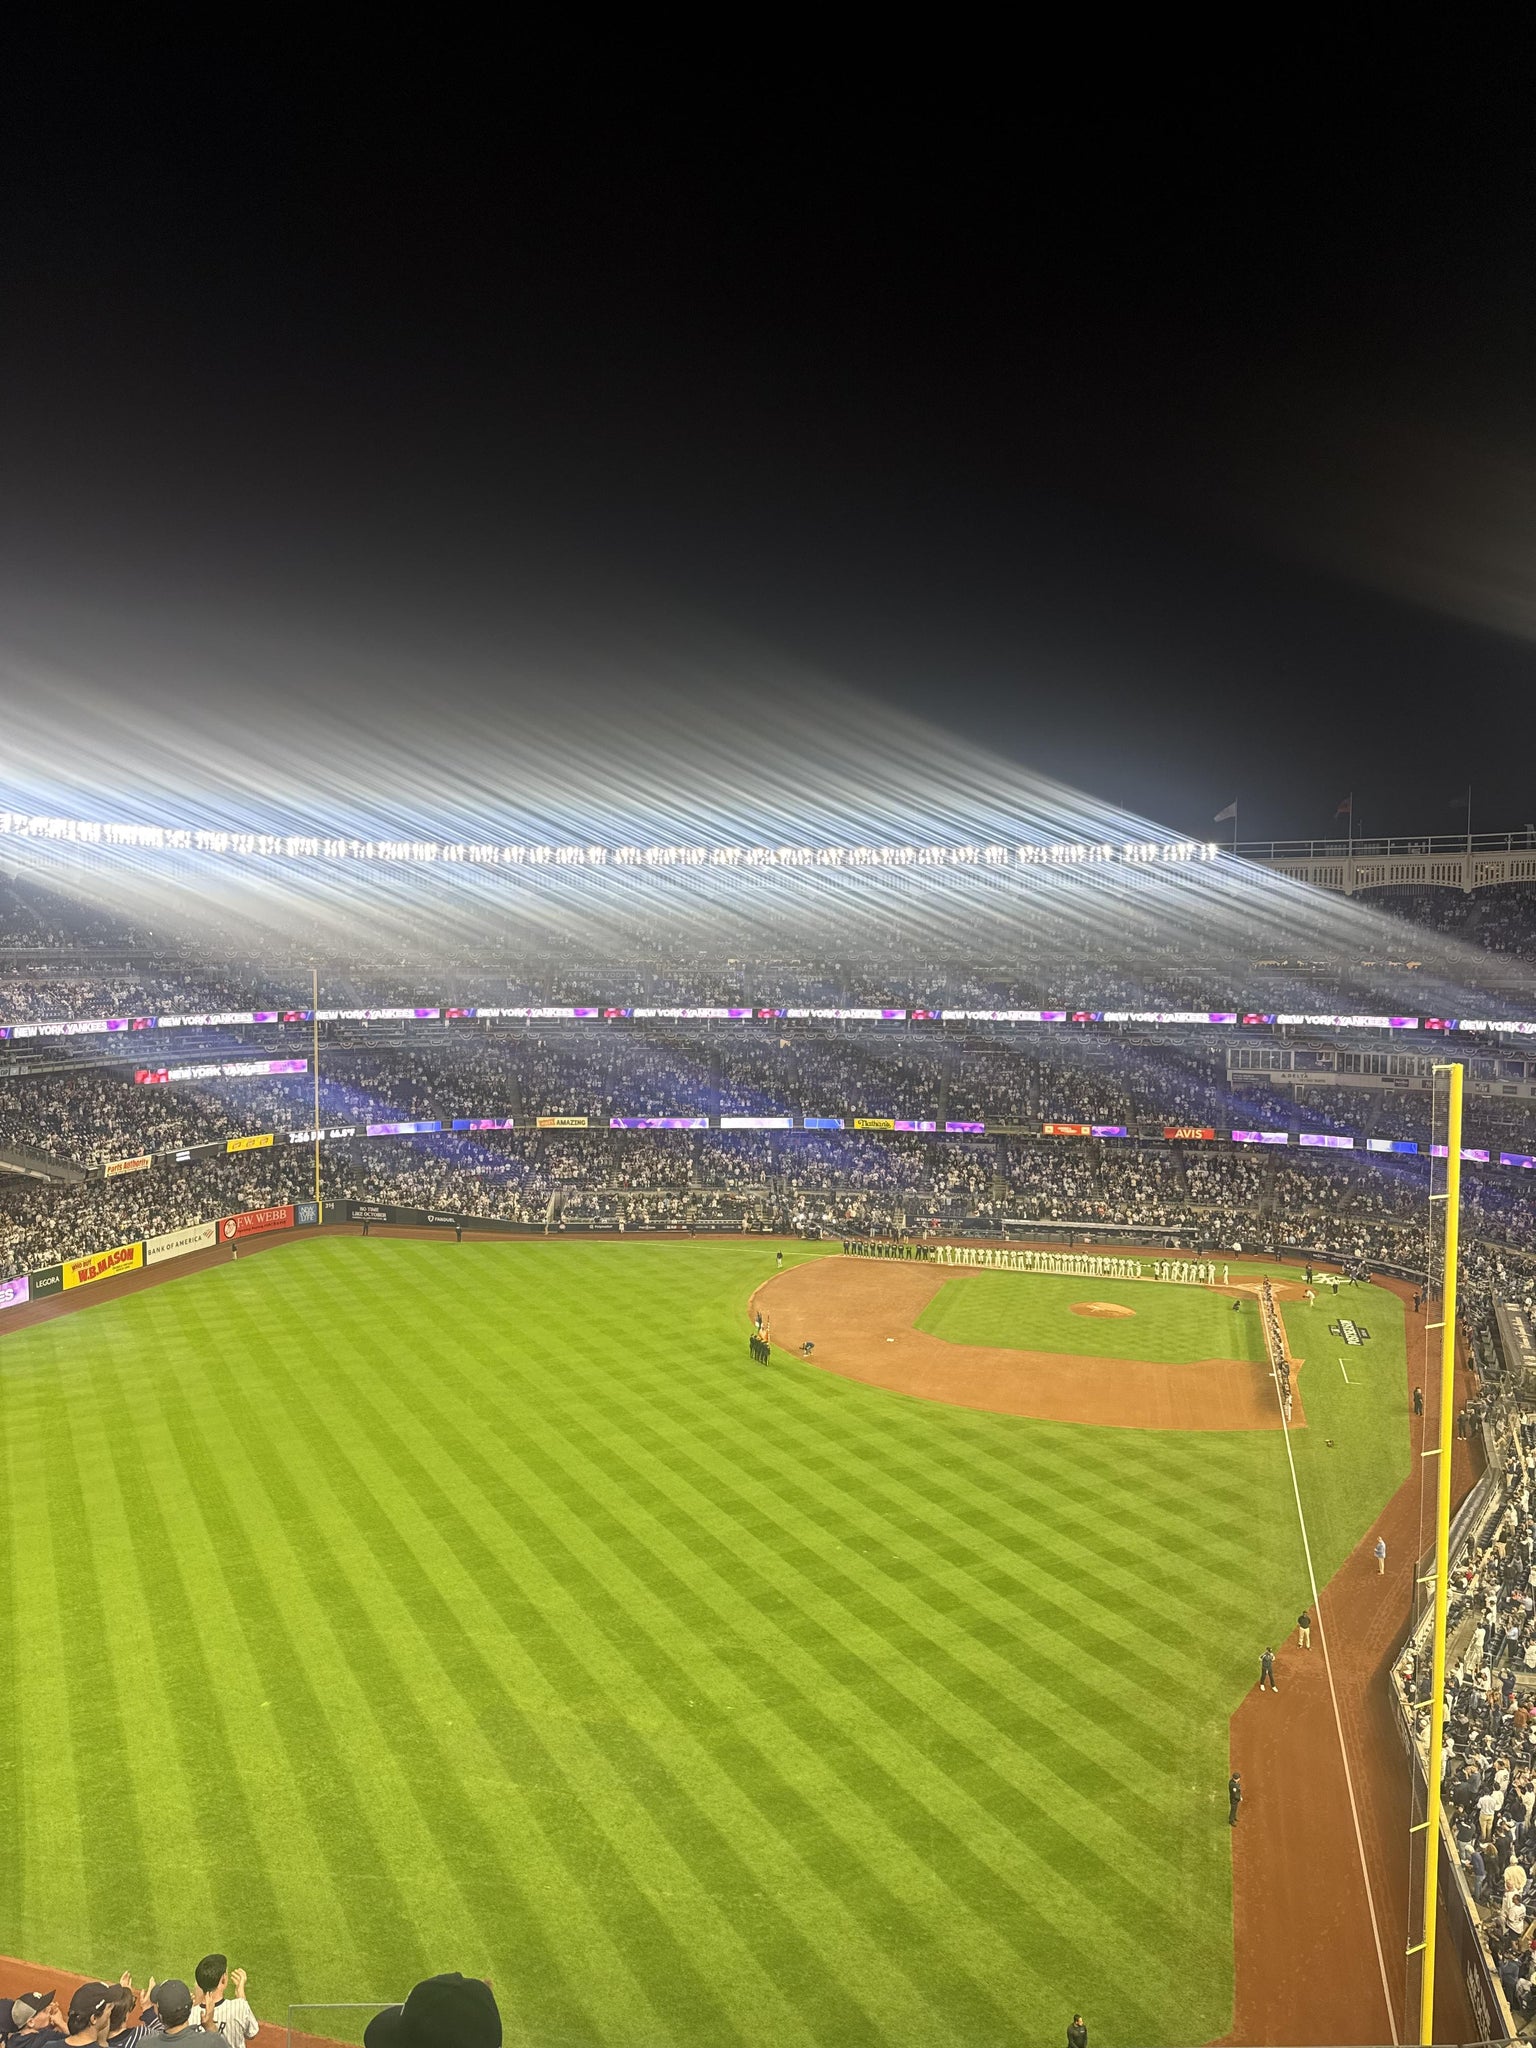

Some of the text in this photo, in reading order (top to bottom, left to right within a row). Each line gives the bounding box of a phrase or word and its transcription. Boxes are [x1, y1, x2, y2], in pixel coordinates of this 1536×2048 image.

[316, 1009, 414, 1020] NEW YORK YANKEES
[476, 1008, 574, 1017] NEW YORK YANKEES
[634, 1009, 728, 1018] NEW YORK YANKEES
[787, 1009, 881, 1019] NEW YORK YANKEES
[942, 1010, 1040, 1020] NEW YORK YANKEES
[1104, 1012, 1209, 1023] NEW YORK YANKEES
[158, 1012, 253, 1028] NEW YORK YANKEES
[1277, 1014, 1389, 1028] NEW YORK YANKEES
[14, 1020, 107, 1039] NEW YORK YANKEES
[1459, 1020, 1487, 1031] NEW
[1488, 1021, 1519, 1033] YORK
[1174, 1128, 1203, 1139] AVIS
[256, 1209, 287, 1223] WEBB
[147, 1235, 203, 1256] BANK OF AMERICA
[35, 1276, 60, 1289] LEGORA
